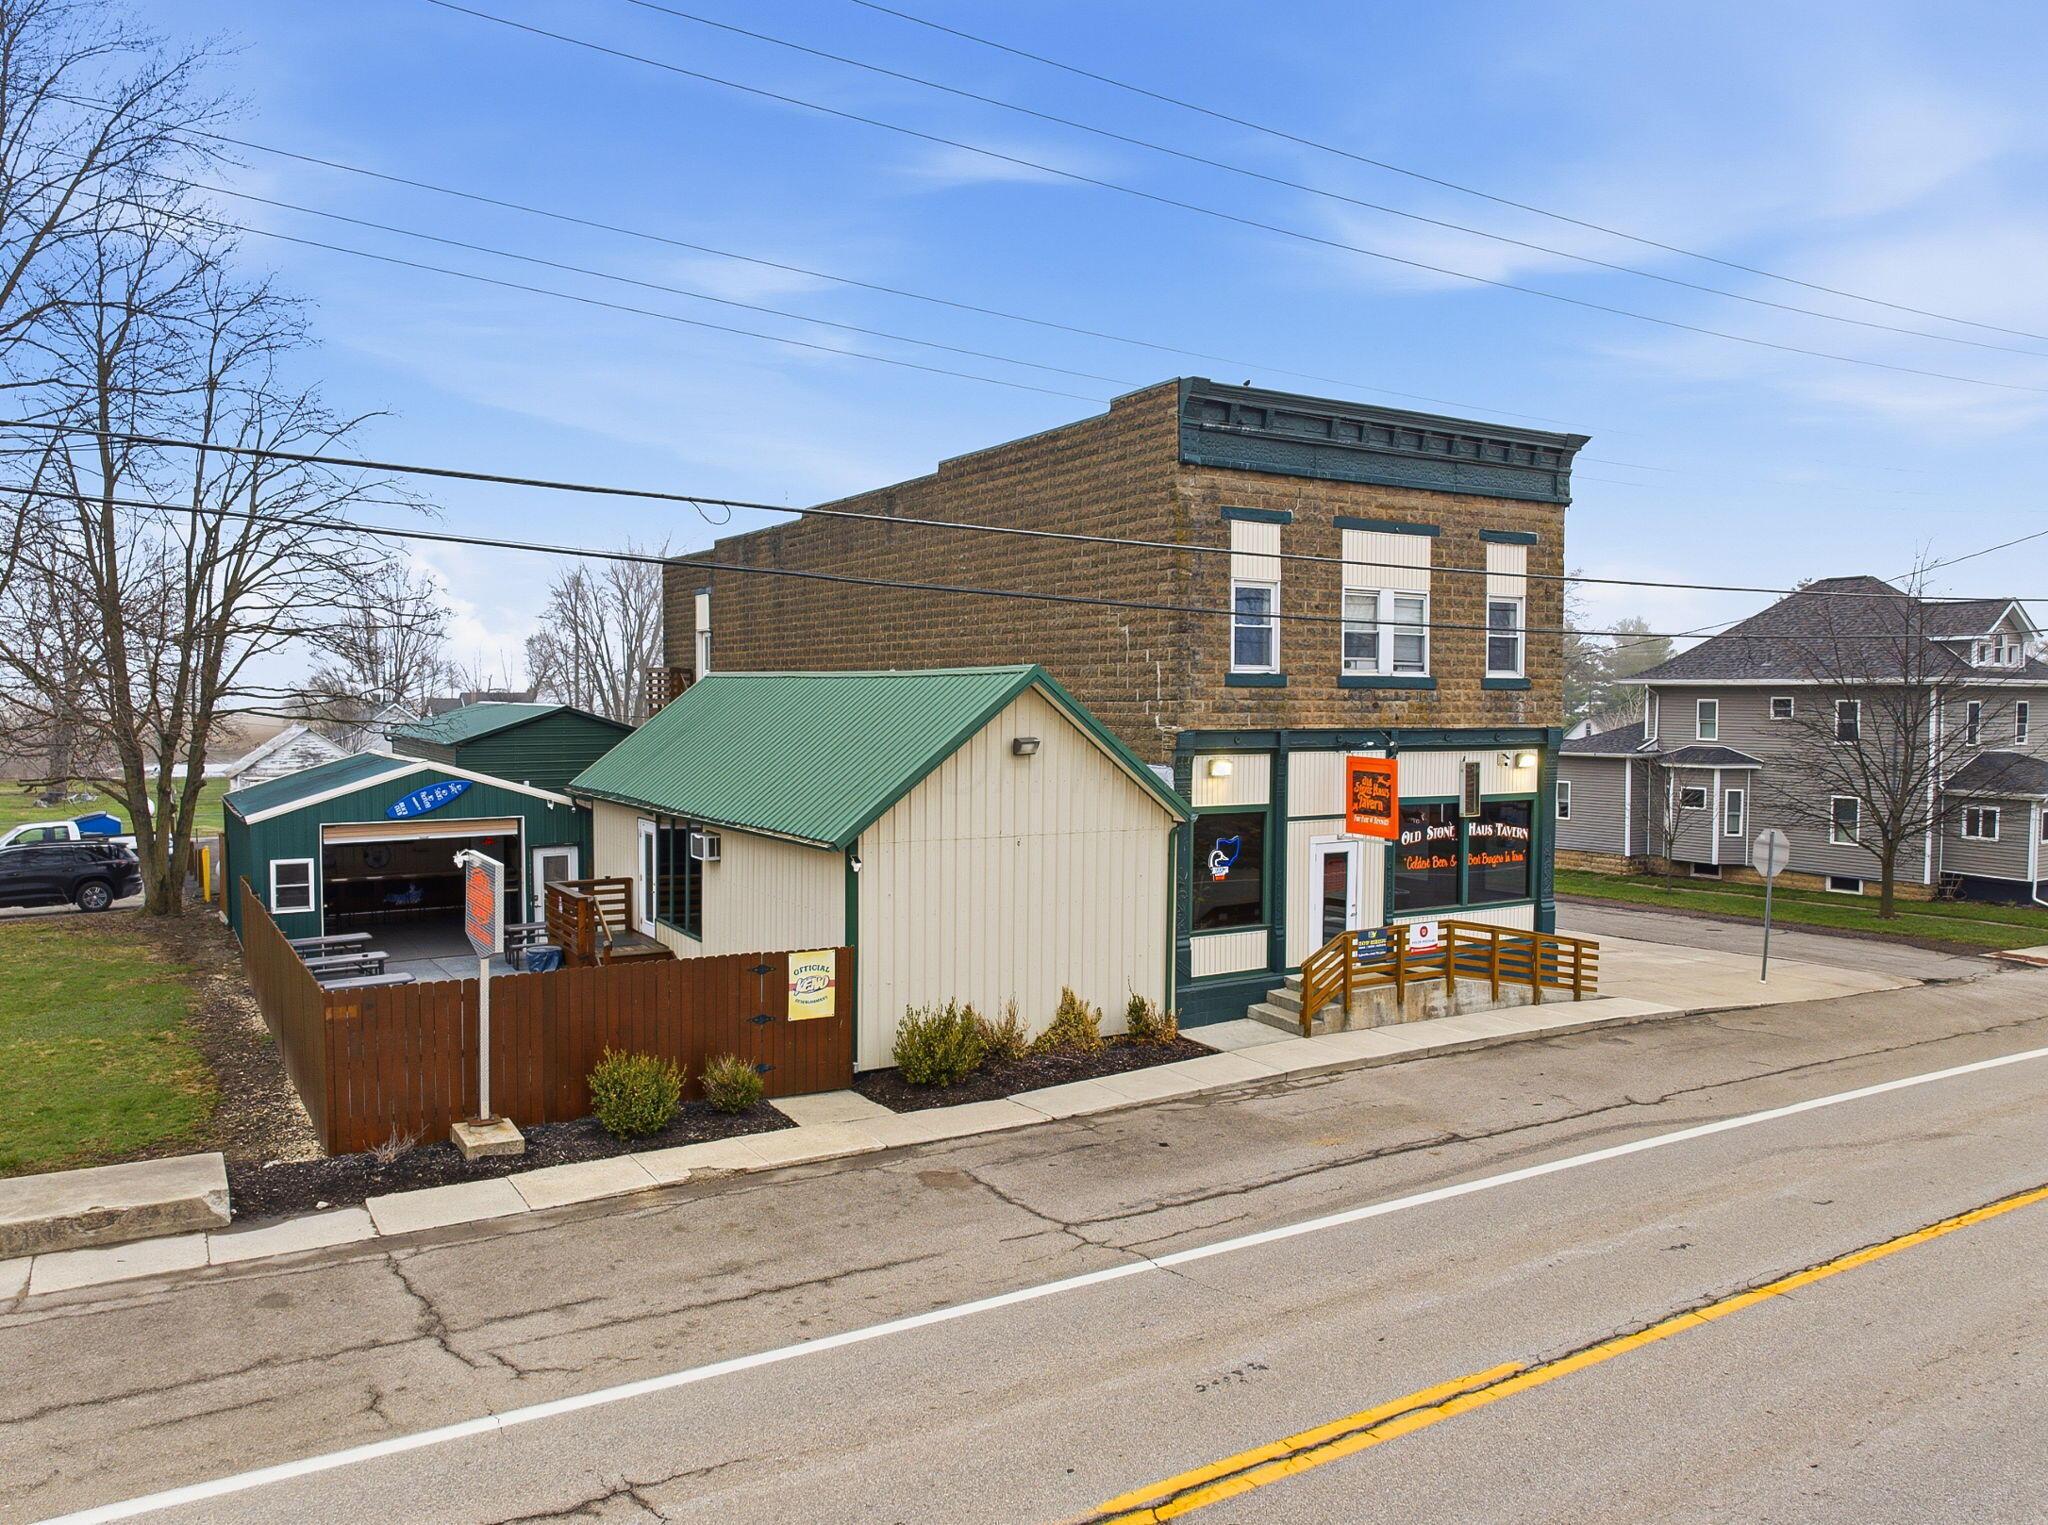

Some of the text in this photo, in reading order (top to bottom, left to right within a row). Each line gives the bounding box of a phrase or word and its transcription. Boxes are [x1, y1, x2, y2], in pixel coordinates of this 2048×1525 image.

[1358, 793, 1384, 812] Tavern
[1432, 855, 1448, 868] Beer
[1450, 854, 1457, 867] &
[1481, 852, 1504, 867] Burgers
[794, 965, 830, 975] OFFICIAL
